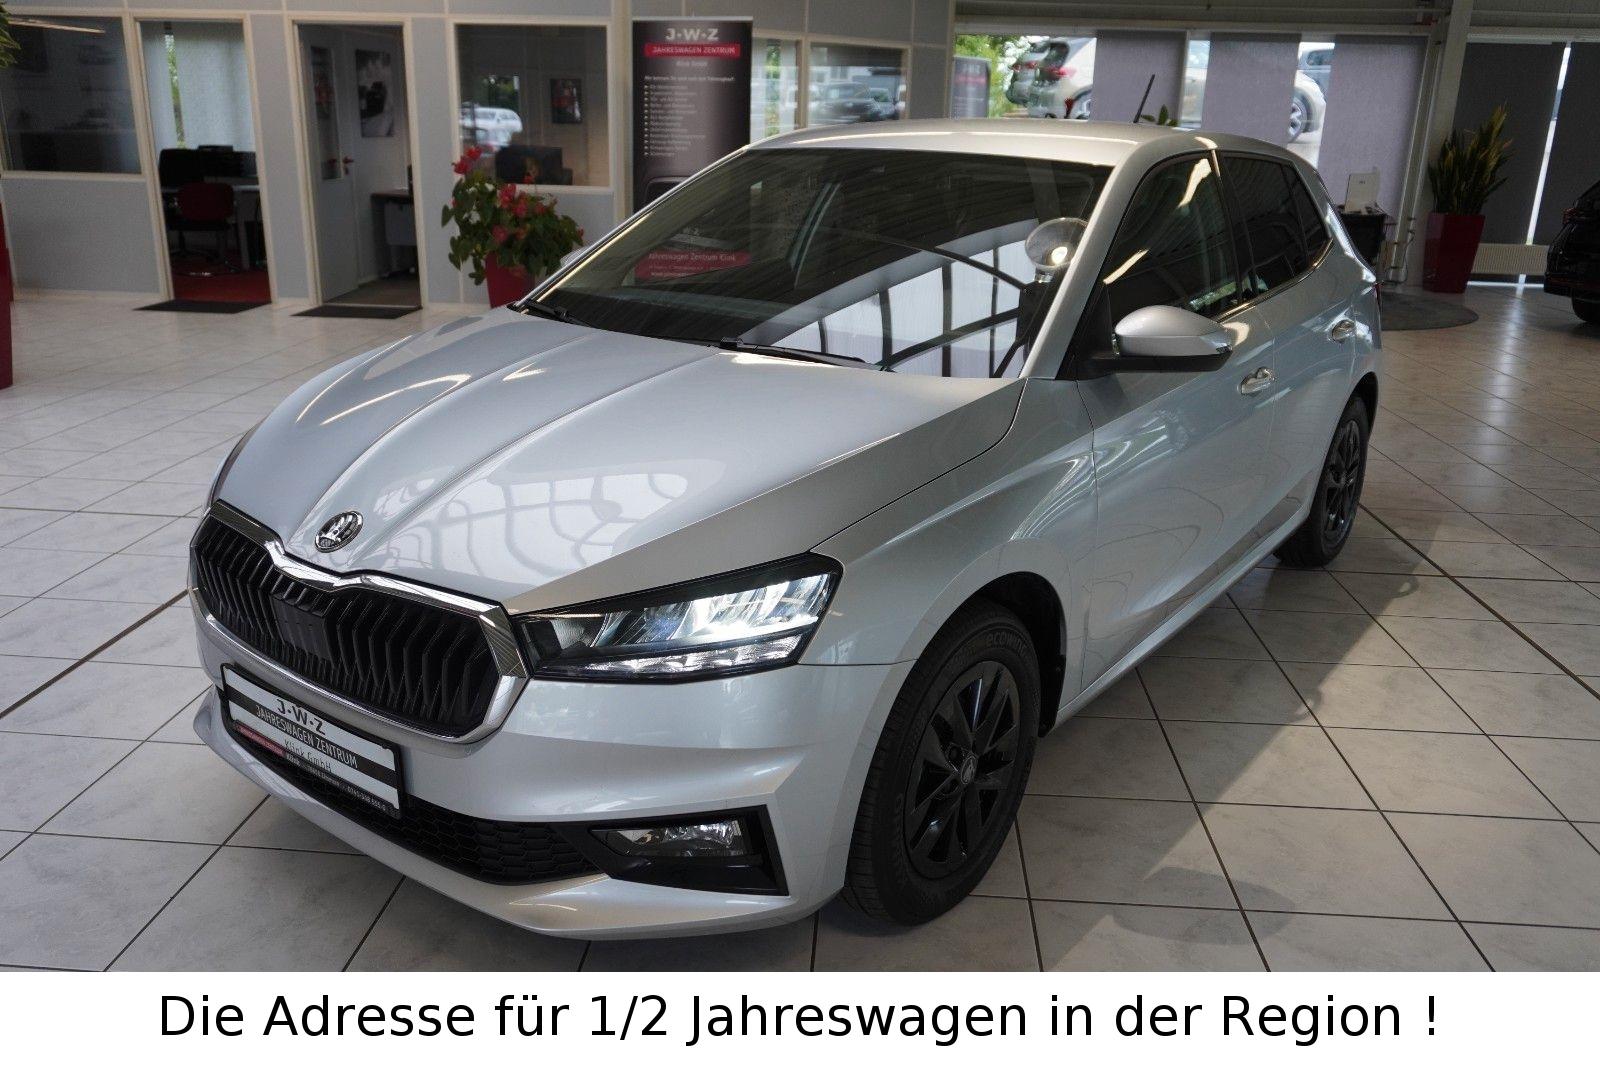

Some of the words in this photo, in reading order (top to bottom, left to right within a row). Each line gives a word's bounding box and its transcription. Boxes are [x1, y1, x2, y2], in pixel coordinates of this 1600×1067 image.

[652, 46, 702, 54] JAHRESWAGEN
[703, 46, 736, 54] ZENTRUM
[255, 704, 315, 746] JAHRESWAGEN
[316, 736, 358, 769] ZENTRUM
